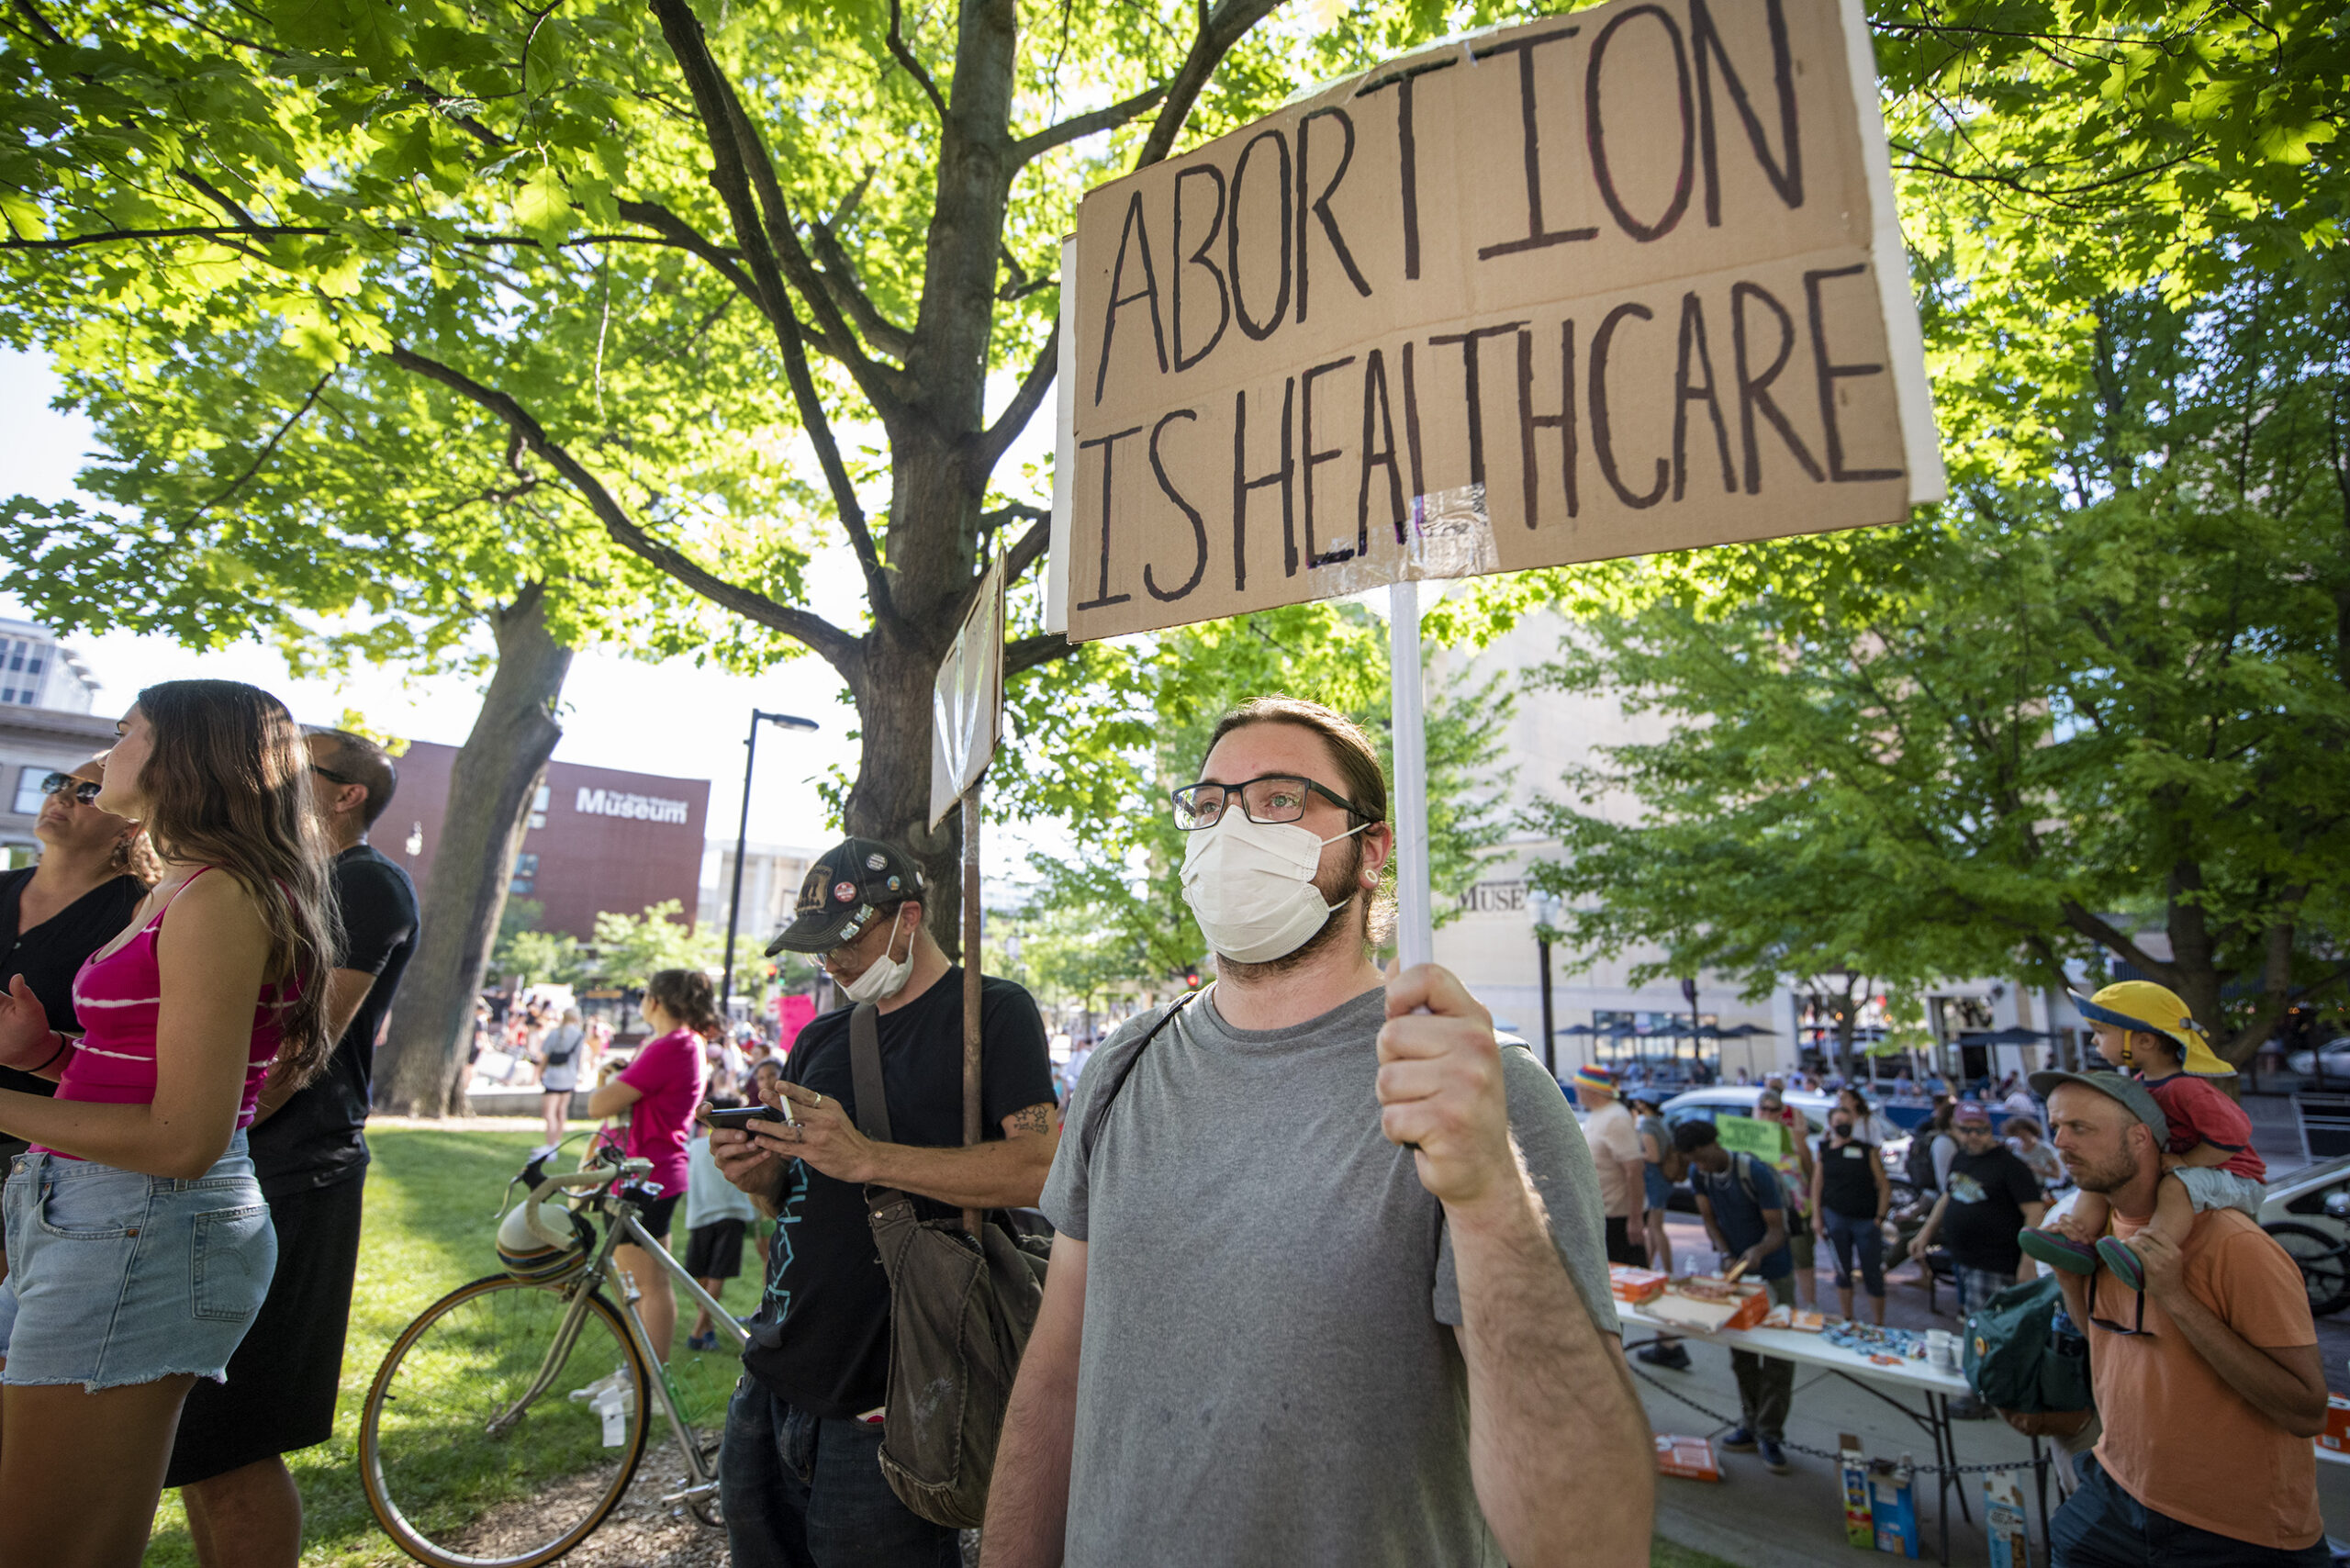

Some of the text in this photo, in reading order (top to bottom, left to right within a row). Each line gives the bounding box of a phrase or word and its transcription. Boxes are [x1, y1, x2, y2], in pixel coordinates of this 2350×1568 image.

[1094, 0, 1804, 406] ABORTION
[1077, 263, 1905, 612] IS HEALTHCARE
[576, 787, 688, 824] Museum
[1459, 885, 1529, 912] MUSE
